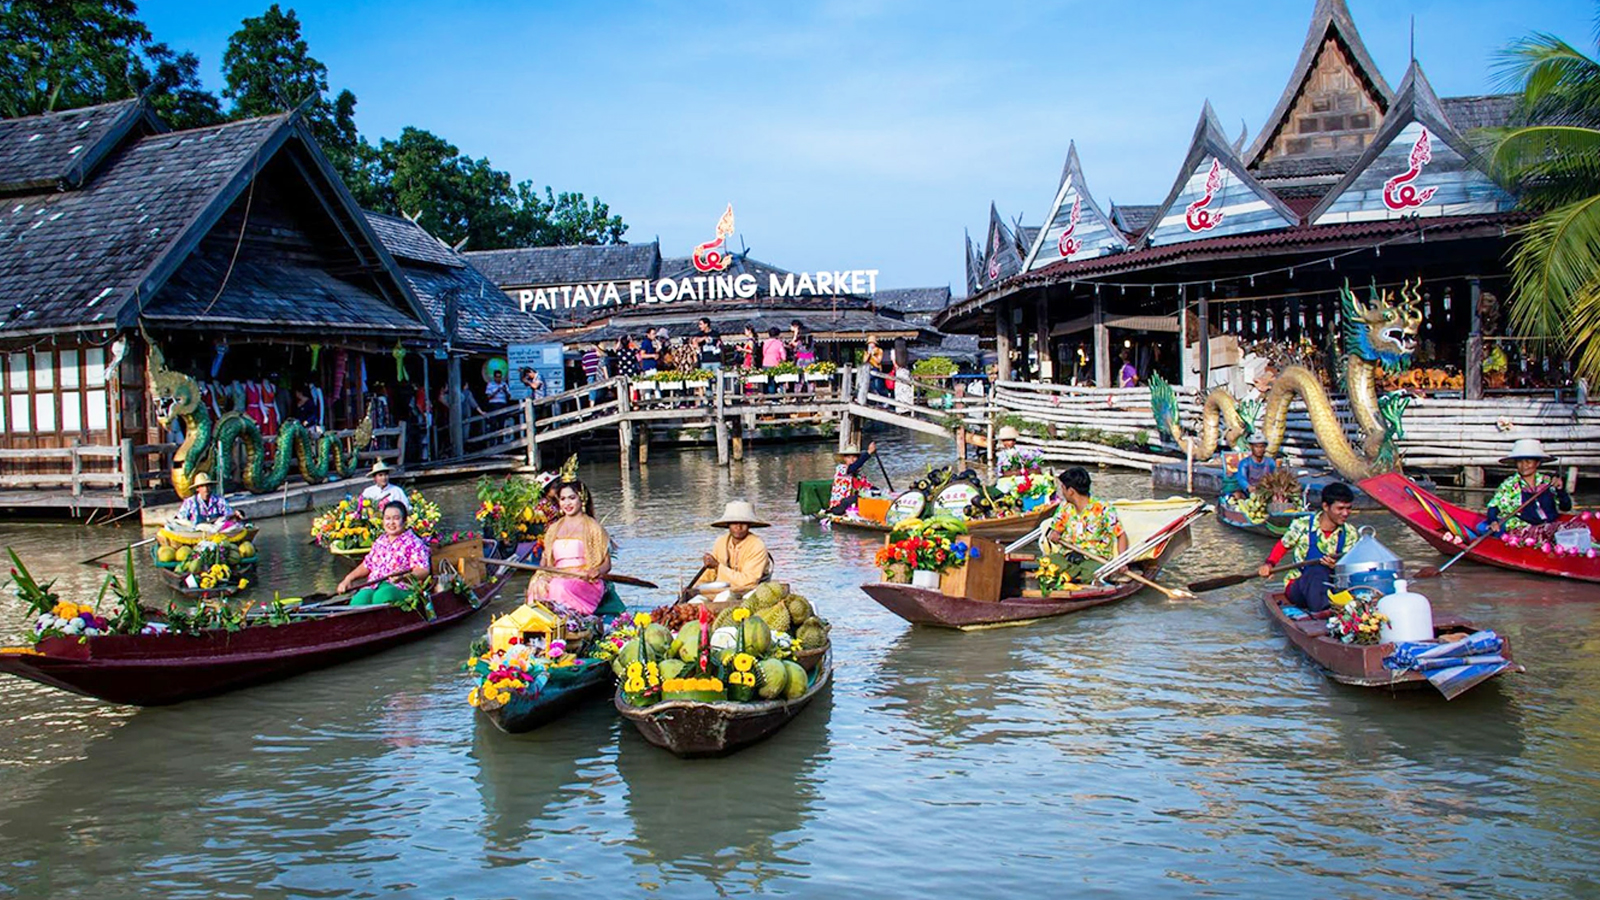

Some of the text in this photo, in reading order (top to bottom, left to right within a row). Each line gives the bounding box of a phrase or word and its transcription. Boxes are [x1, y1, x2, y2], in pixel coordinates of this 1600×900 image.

[518, 269, 879, 313] PATTAYA FLOATING MARKET
